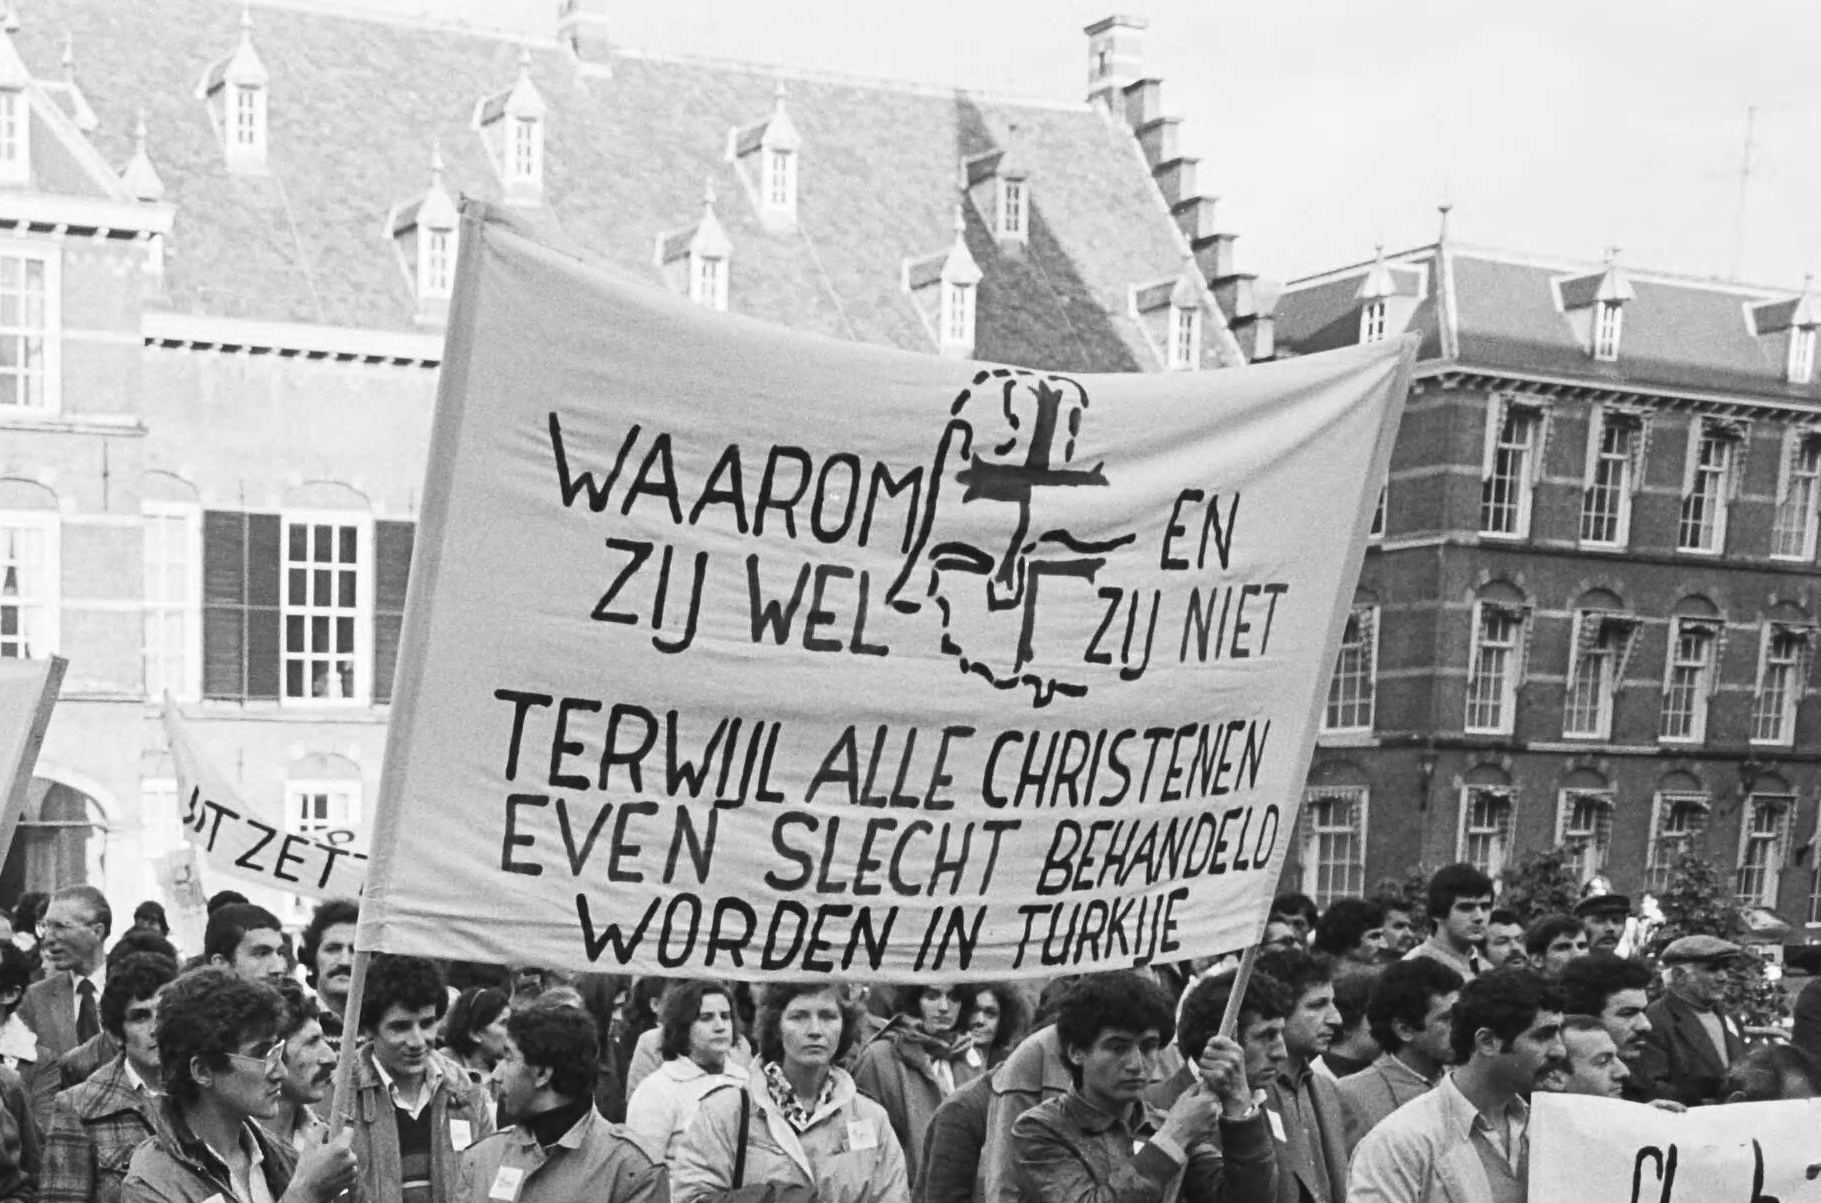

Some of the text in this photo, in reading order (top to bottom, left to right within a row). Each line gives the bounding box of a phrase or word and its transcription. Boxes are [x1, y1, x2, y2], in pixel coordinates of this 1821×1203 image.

[549, 412, 923, 553] WAAROM
[1161, 489, 1239, 570] EN
[591, 538, 889, 656] ZIJ WEL
[1084, 584, 1289, 681] ZIJ NIET
[494, 690, 1271, 811] TERWIJL ALLE CHRISTENEN
[501, 794, 1279, 896] EVEN SLECHT BEHANDELD
[576, 888, 1191, 974] WORDEN IN TURKIJE
